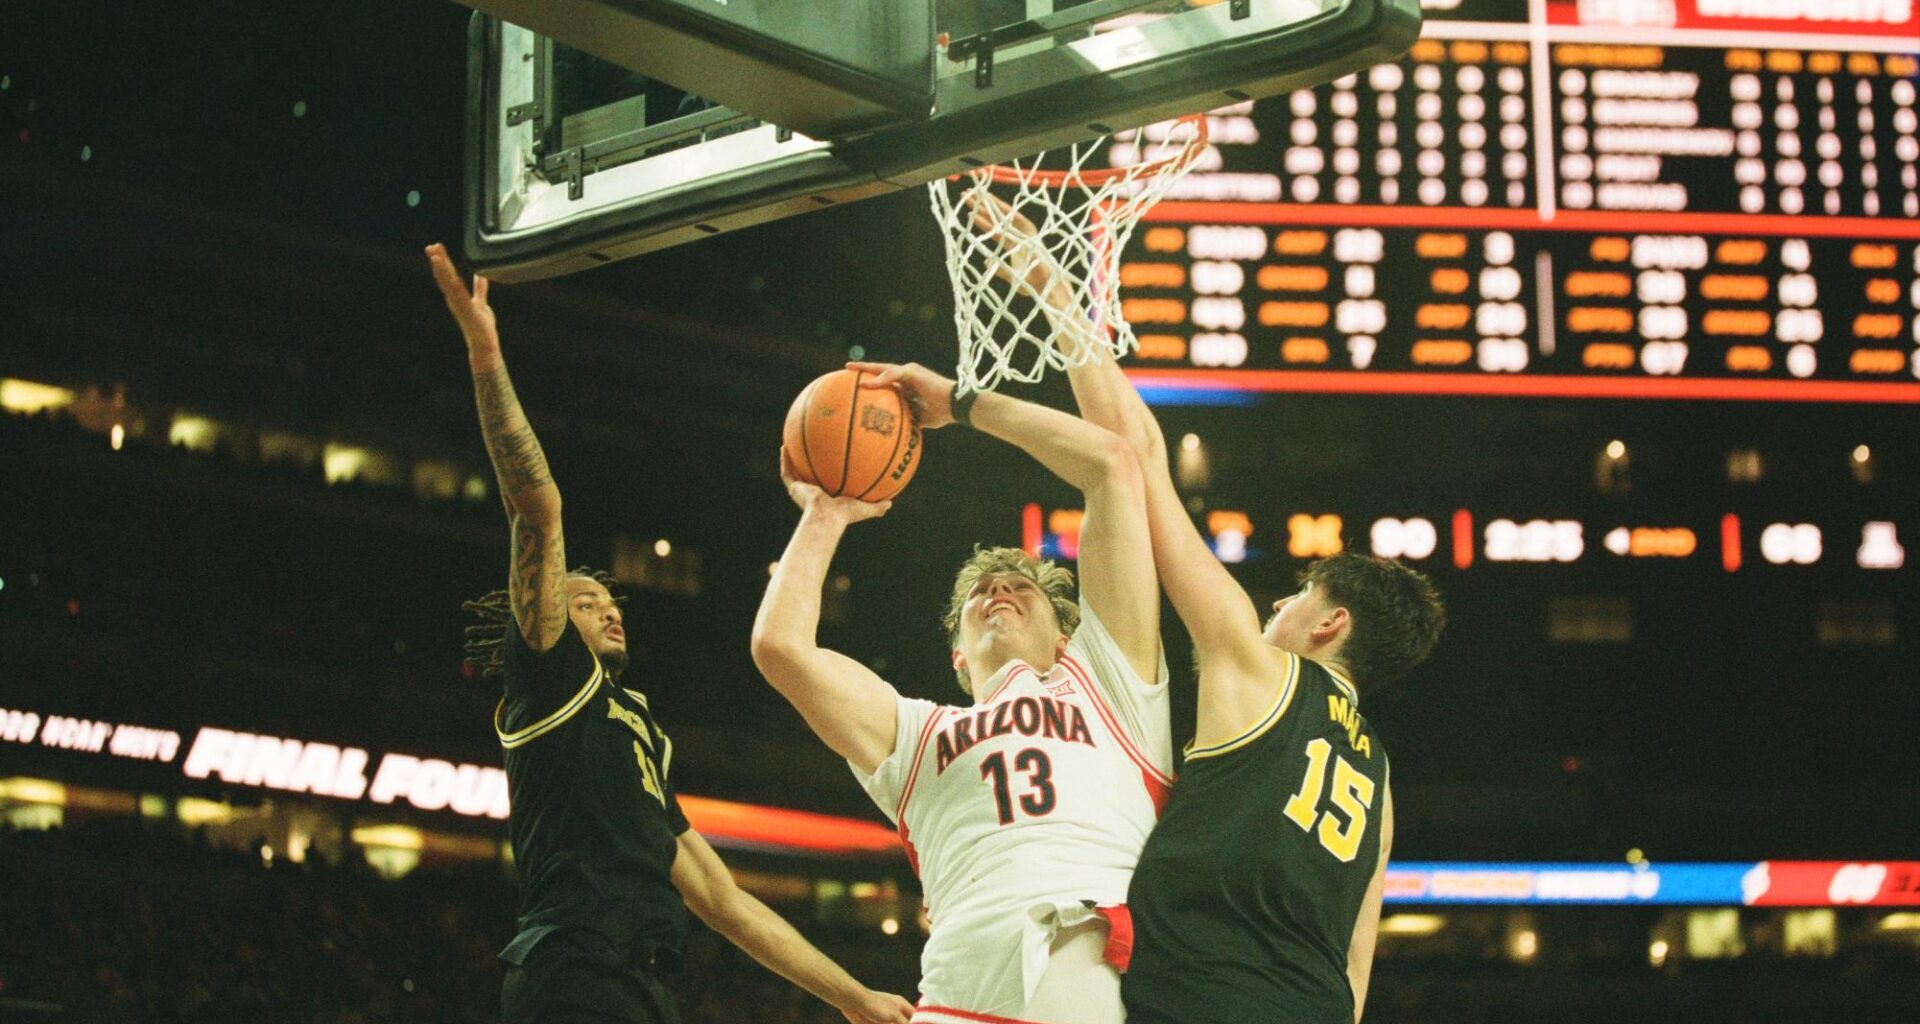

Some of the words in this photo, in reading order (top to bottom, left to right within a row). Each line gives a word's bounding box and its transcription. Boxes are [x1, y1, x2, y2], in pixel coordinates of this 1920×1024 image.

[183, 727, 368, 799] FINAL
[936, 697, 1096, 776] ARIZONA
[979, 747, 1057, 827] 13
[1283, 738, 1375, 863] 15
